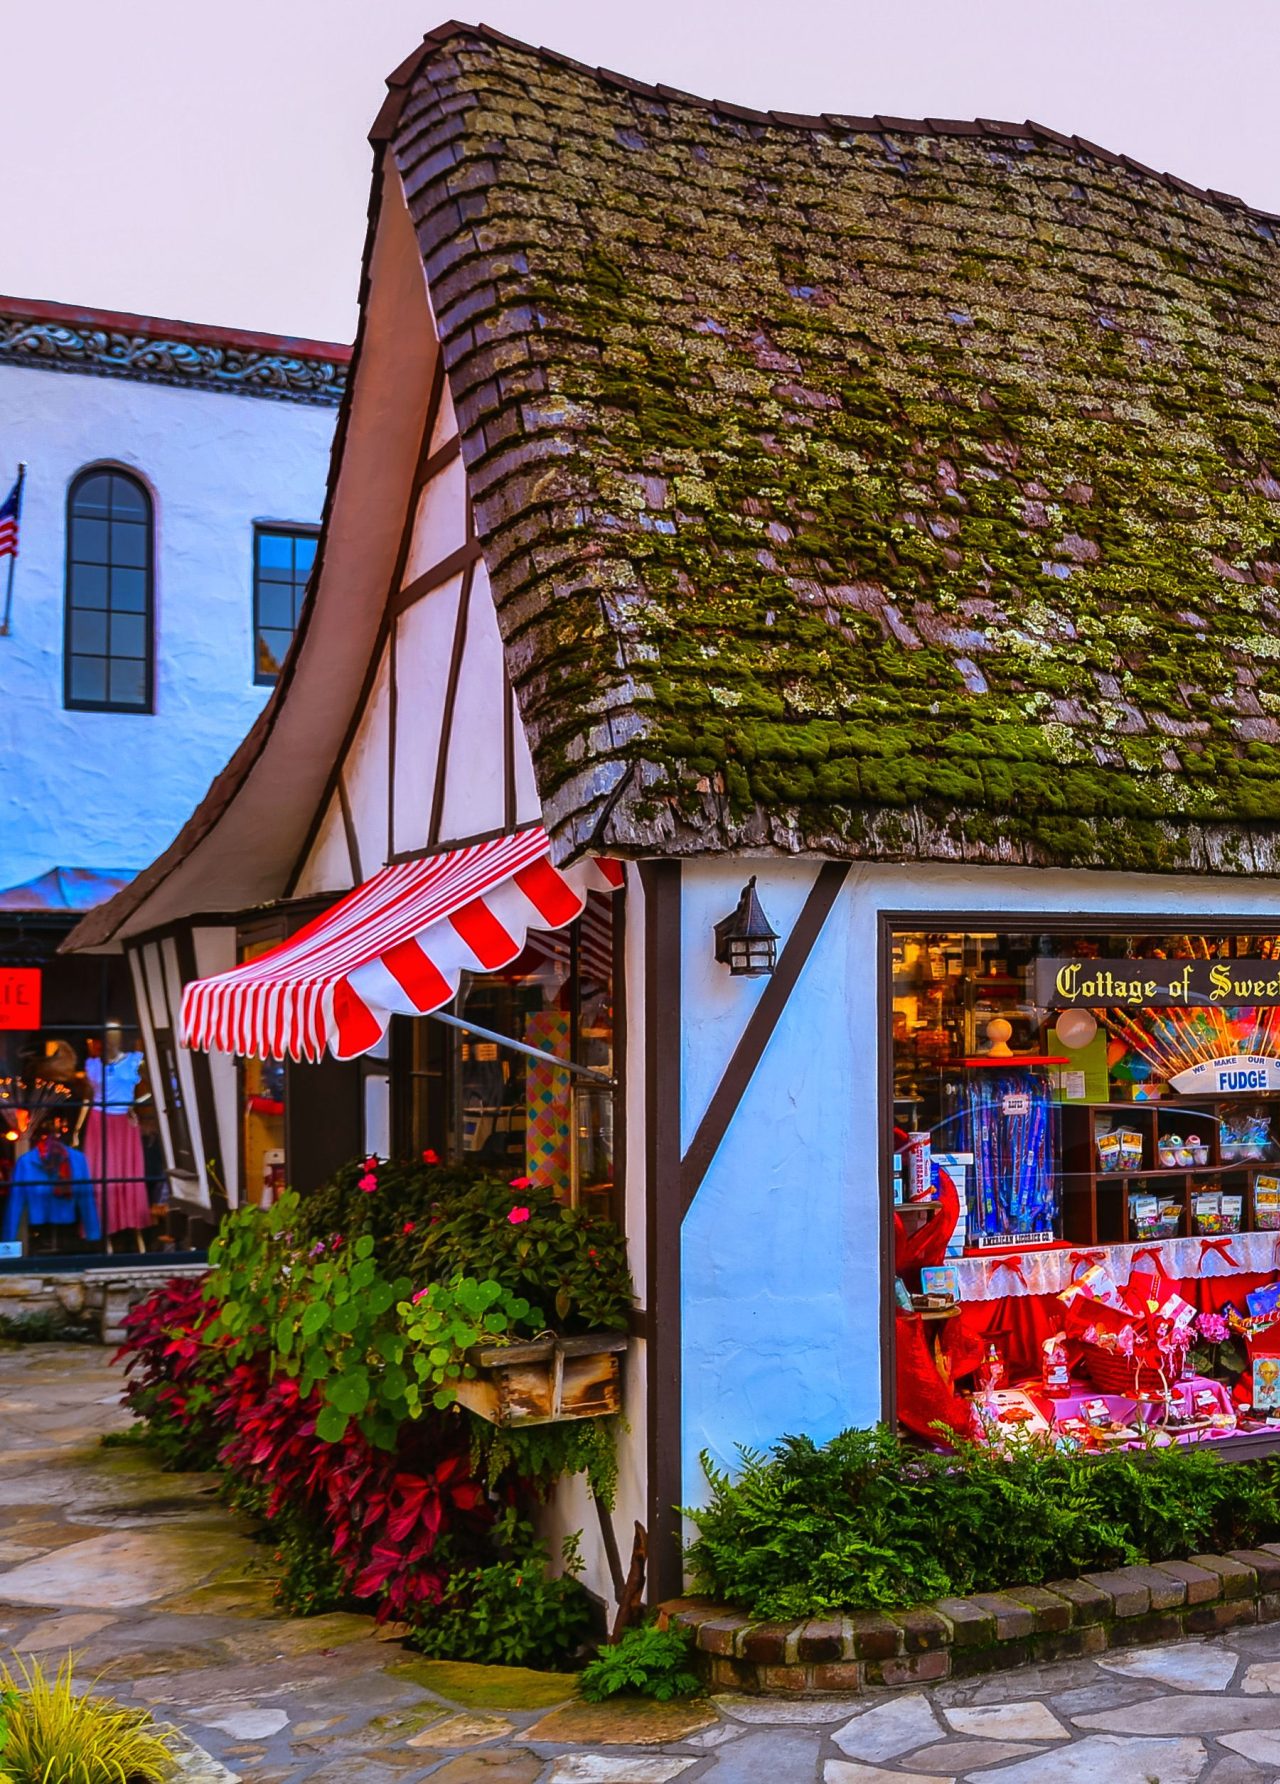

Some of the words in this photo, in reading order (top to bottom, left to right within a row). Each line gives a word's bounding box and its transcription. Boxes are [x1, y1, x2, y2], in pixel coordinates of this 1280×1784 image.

[1055, 963, 1159, 1004] Cottage
[1168, 963, 1195, 1004] of
[1192, 1065, 1206, 1075] WE
[1213, 1057, 1238, 1067] MAKE
[1247, 1056, 1265, 1065] OUR
[1219, 1069, 1268, 1091] FUDGE
